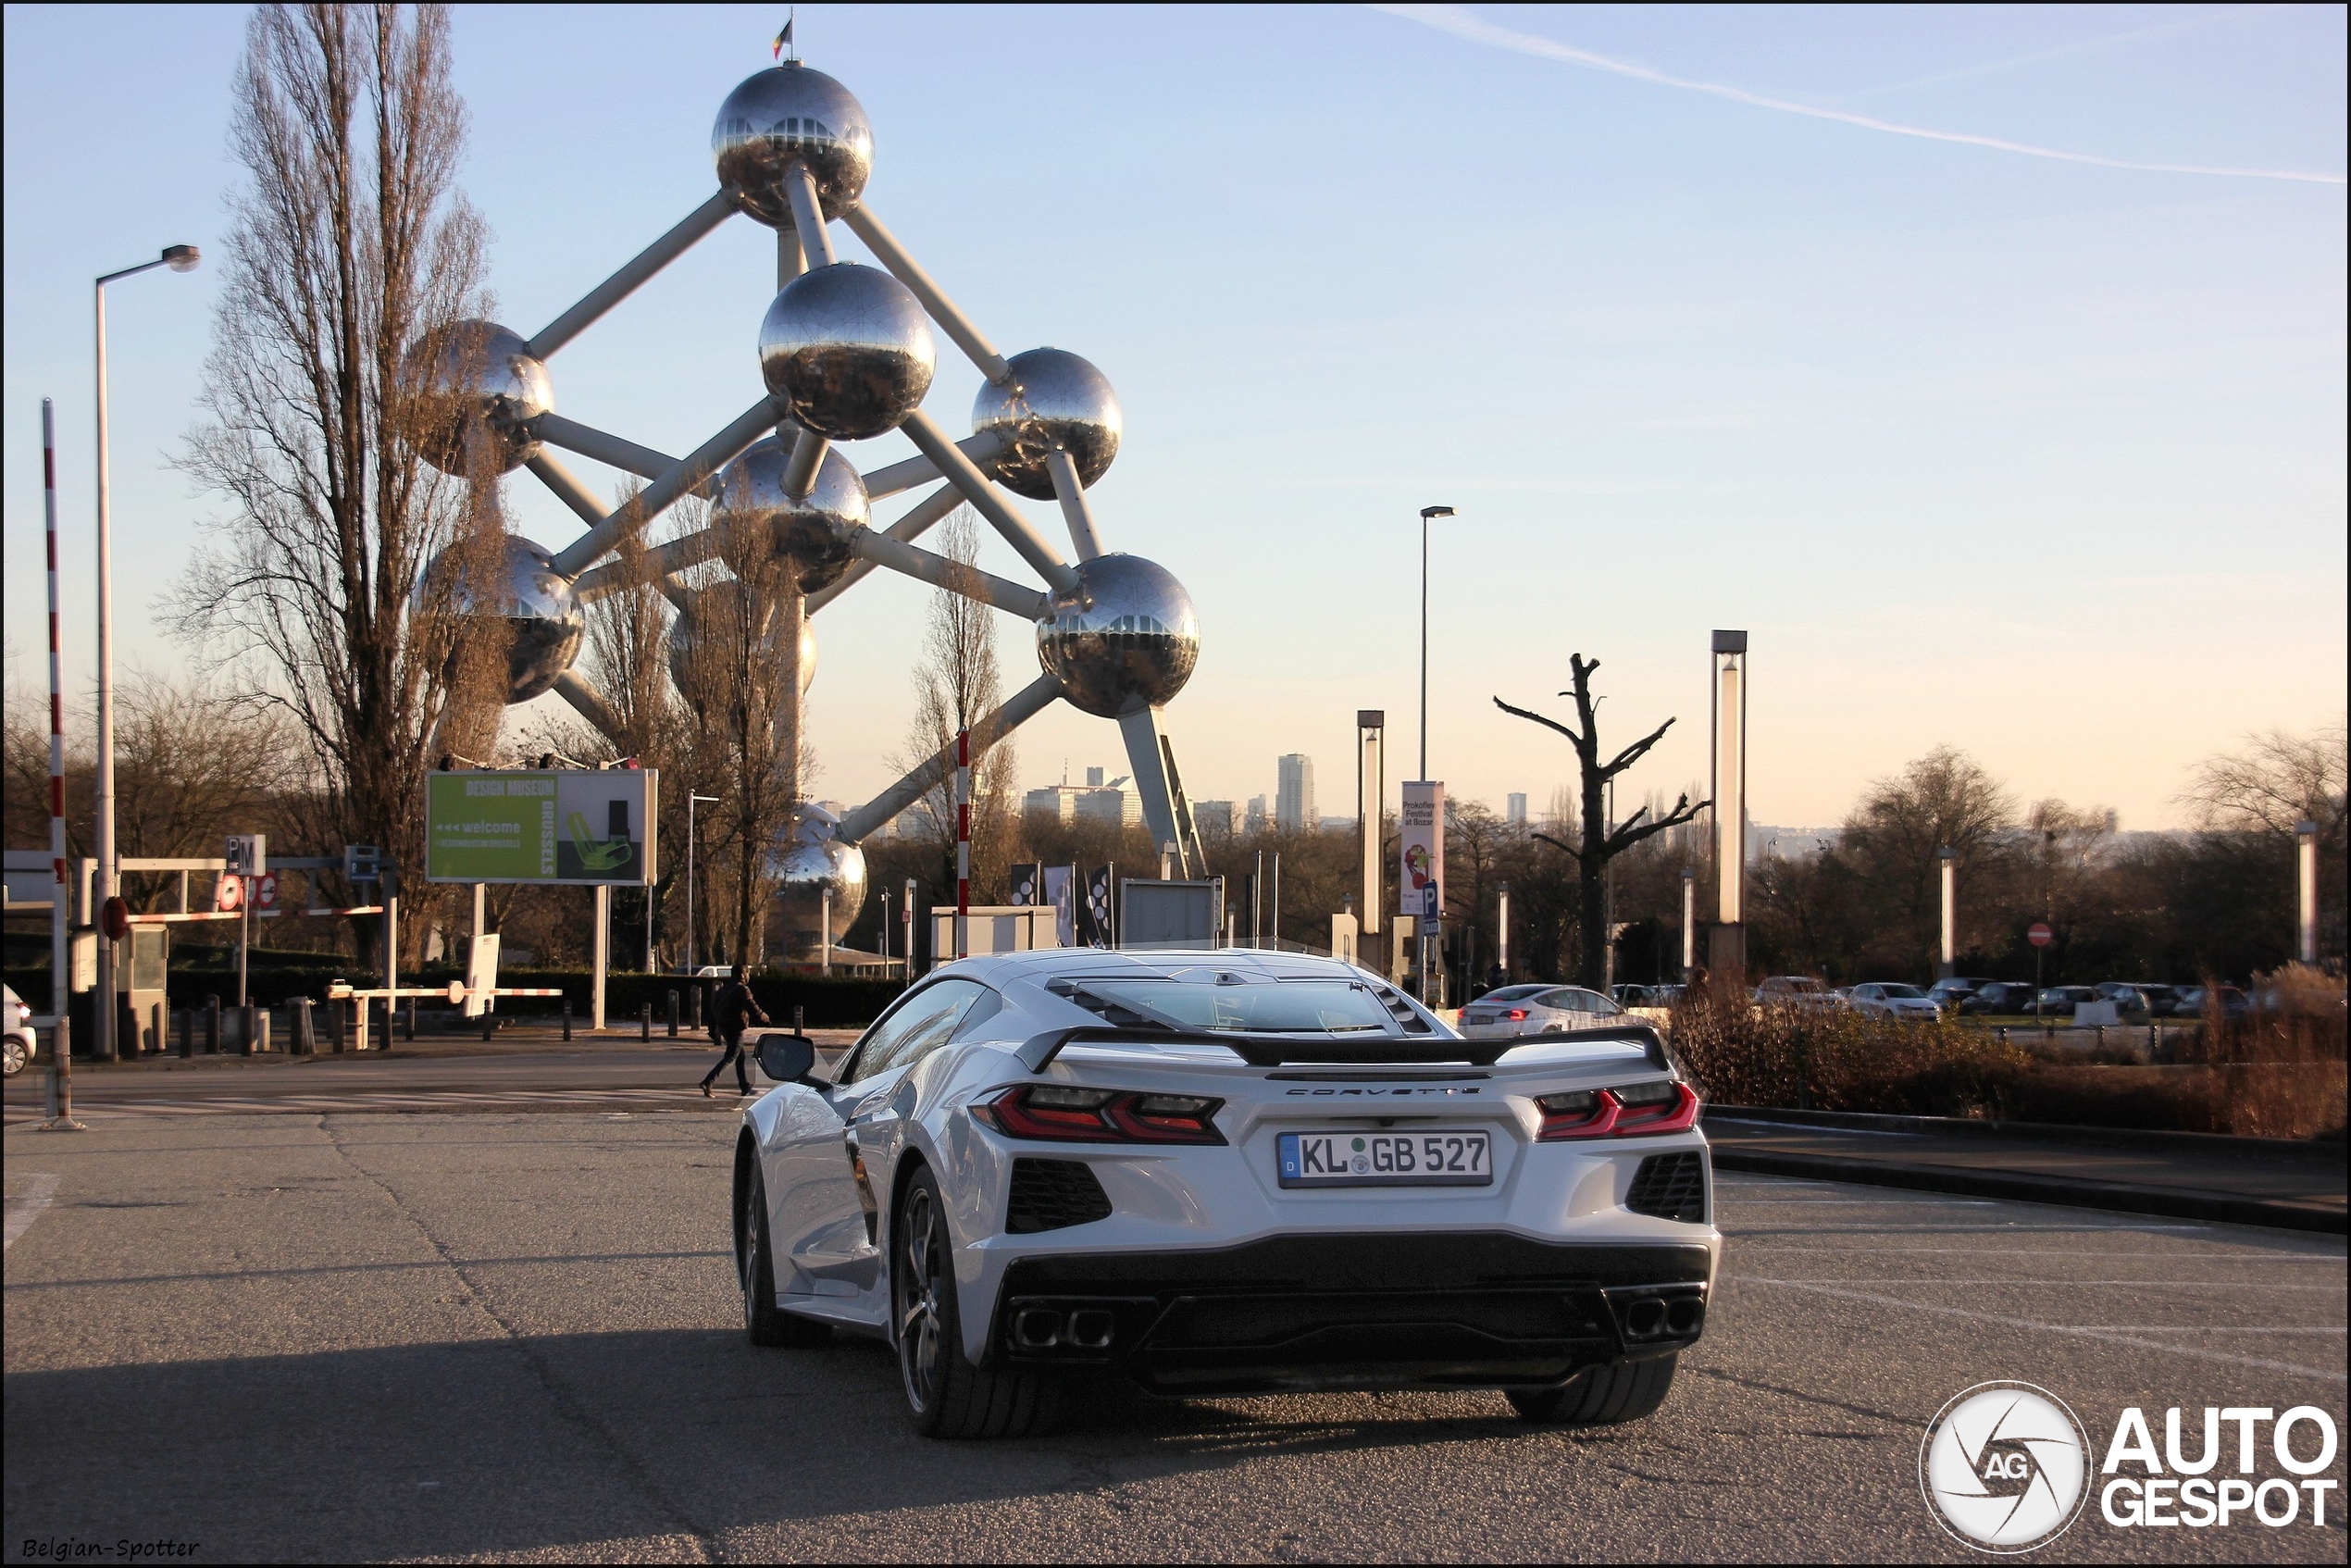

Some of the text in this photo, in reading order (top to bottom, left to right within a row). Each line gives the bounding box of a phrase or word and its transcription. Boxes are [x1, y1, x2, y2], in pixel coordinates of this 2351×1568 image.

[466, 779, 555, 797] DESIGN MUSEUM
[1405, 809, 1433, 817] Festival
[462, 818, 521, 834] welcome
[1413, 817, 1434, 826] Bozar
[541, 800, 554, 876] BRUSSELS
[1424, 888, 1436, 915] P
[1285, 1087, 1482, 1096] CORVETTE
[1301, 1137, 1485, 1174] KL GB 527
[1286, 1161, 1294, 1172] D
